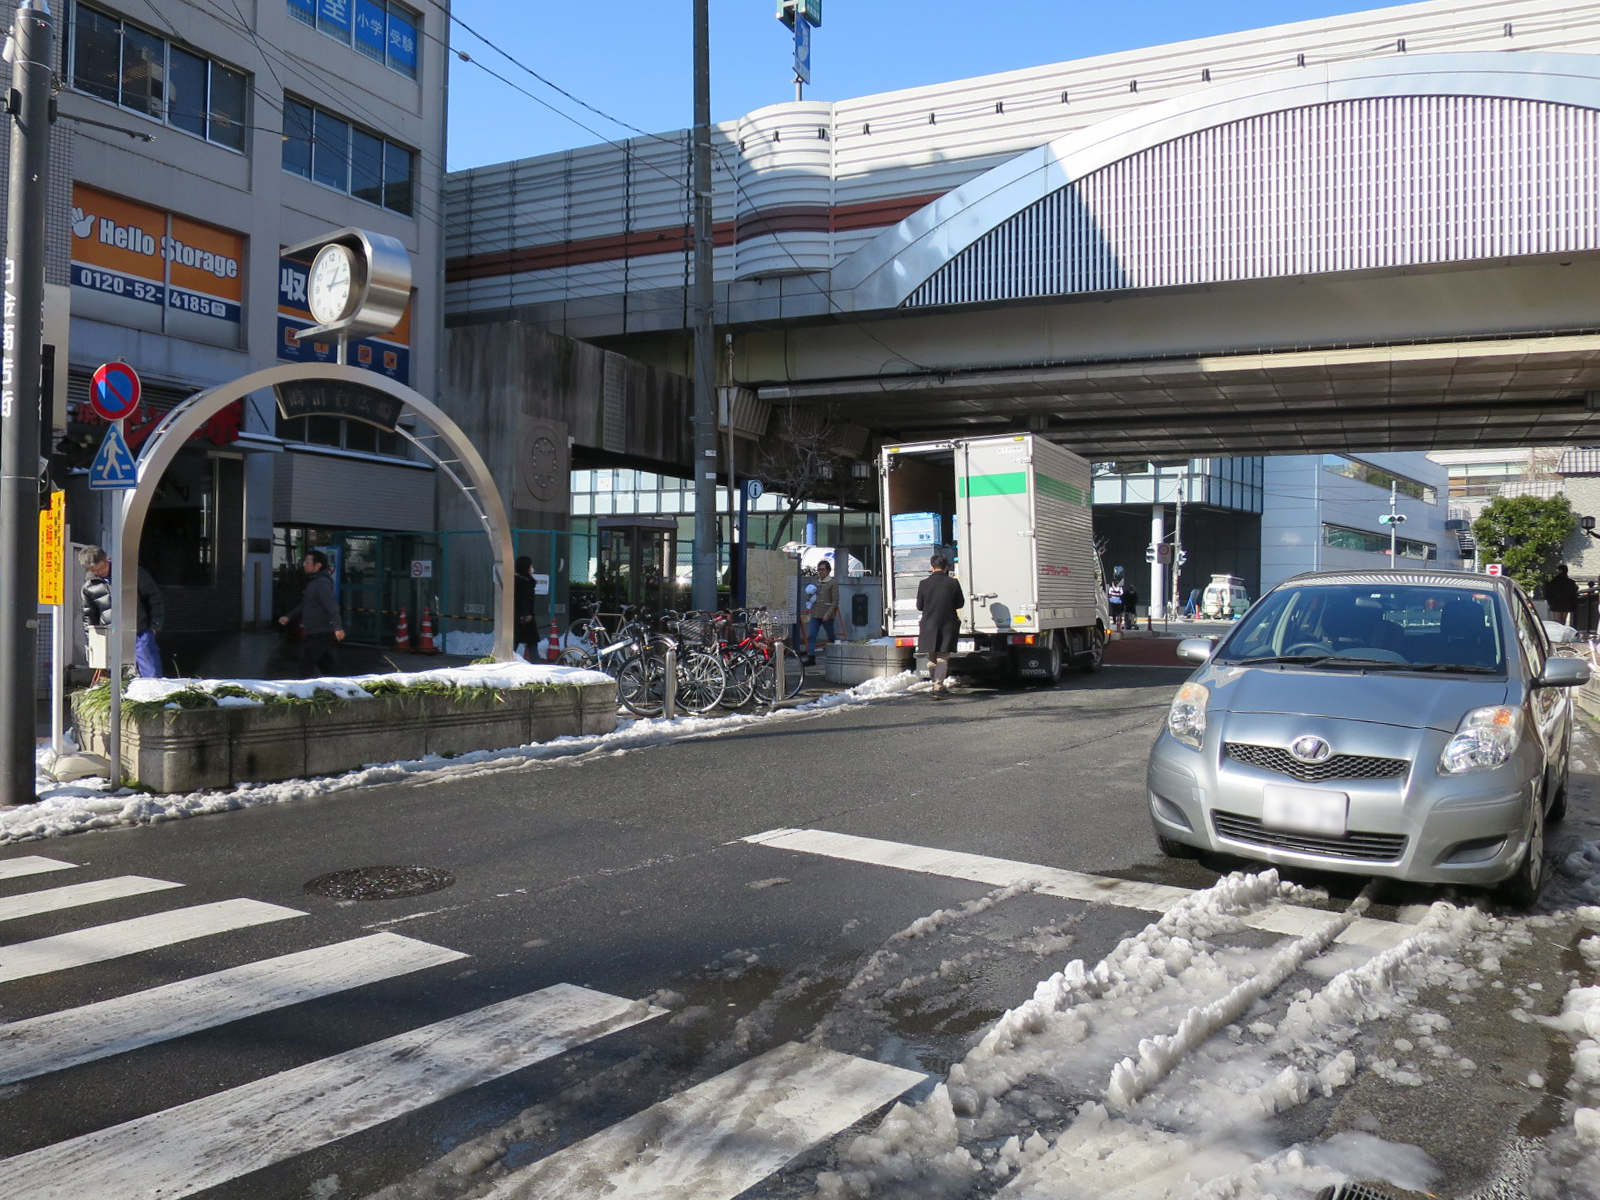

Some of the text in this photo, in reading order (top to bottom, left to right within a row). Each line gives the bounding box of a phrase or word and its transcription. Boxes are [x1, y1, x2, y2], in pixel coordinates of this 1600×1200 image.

[99, 217, 238, 278] Hello Storage
[80, 269, 209, 314] 0120-52-4185
[281, 268, 306, 303] 収
